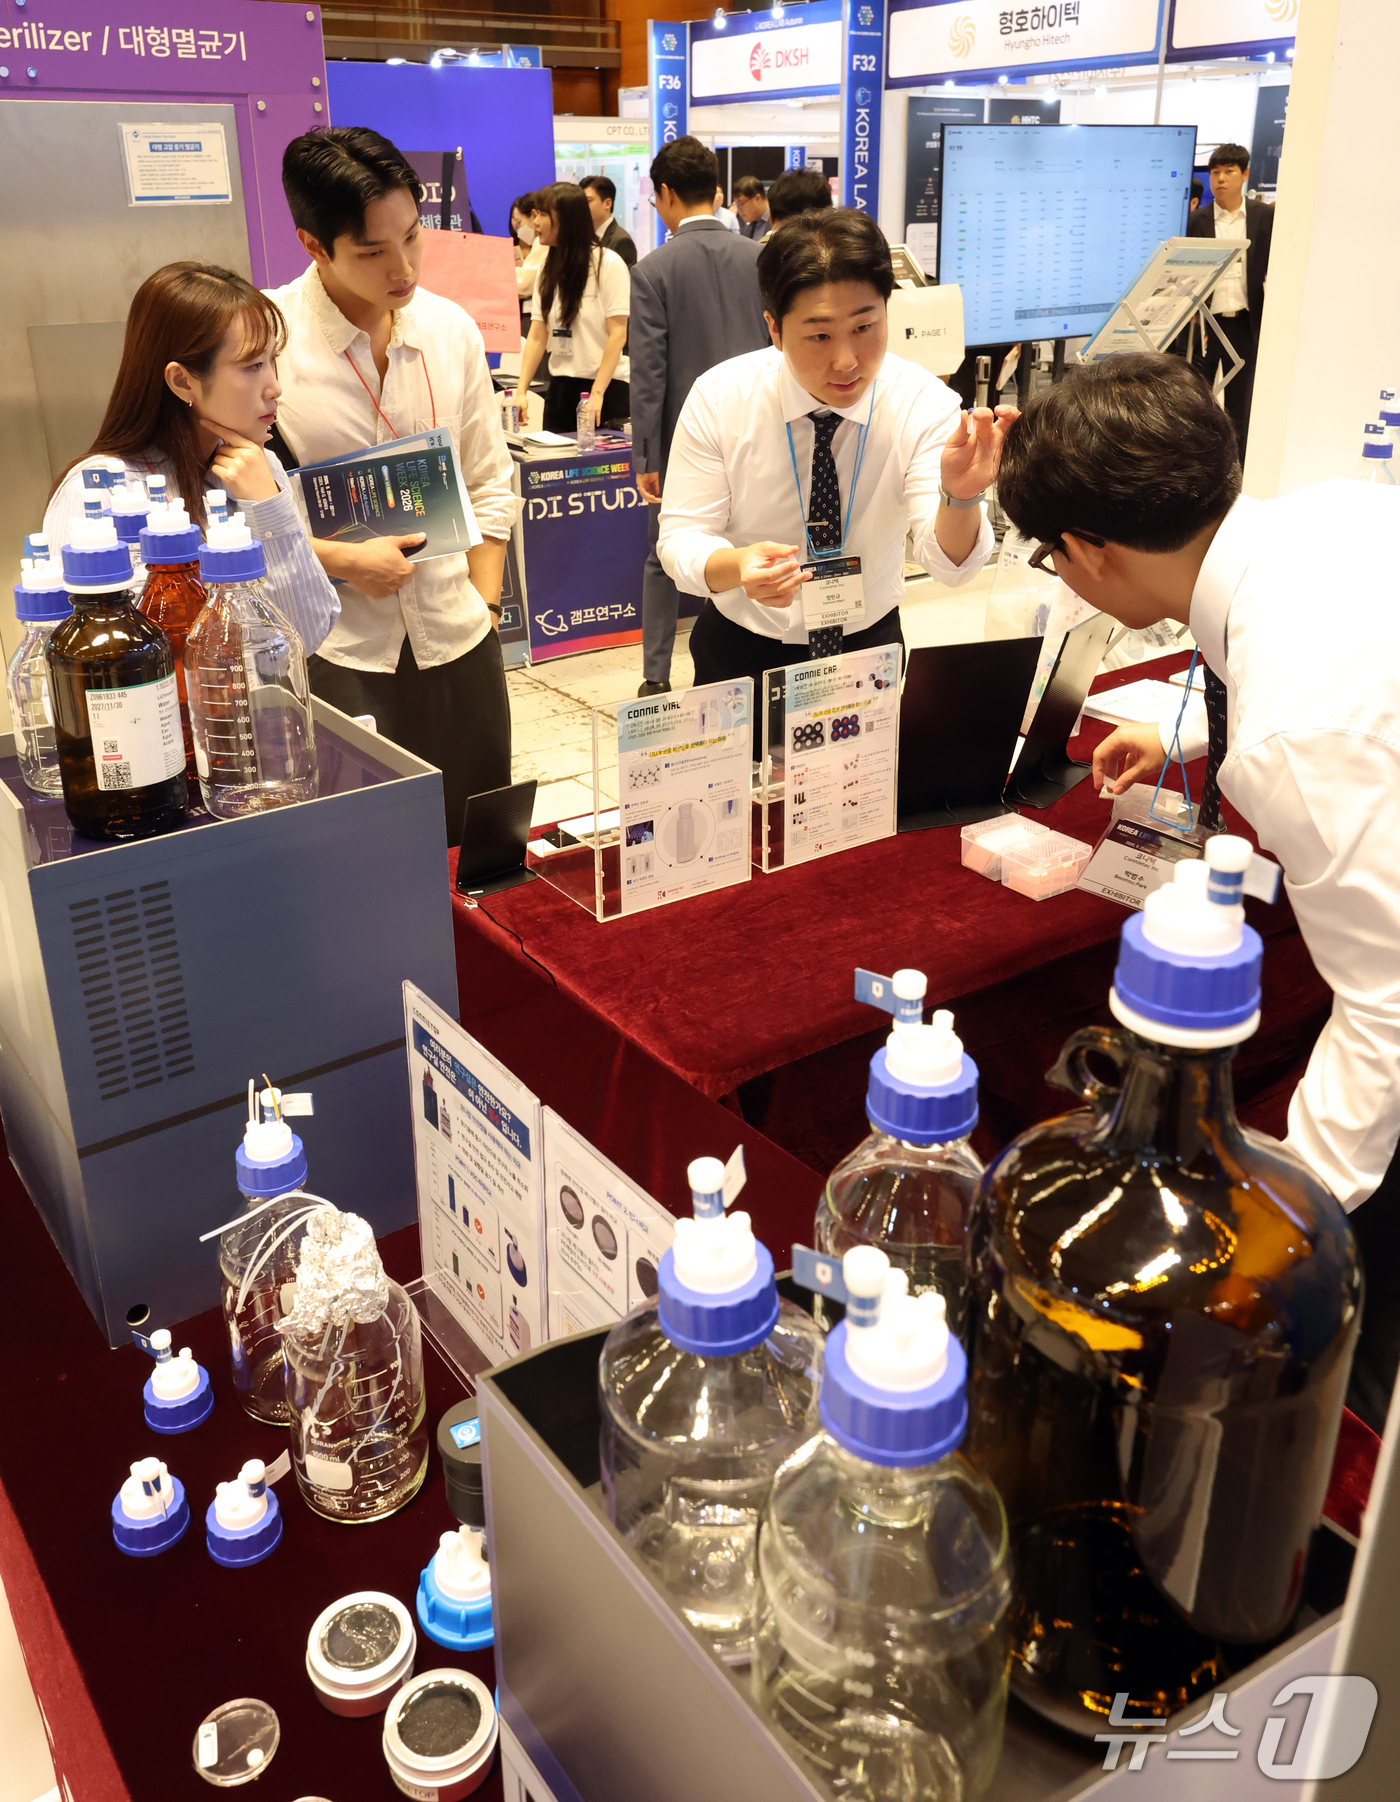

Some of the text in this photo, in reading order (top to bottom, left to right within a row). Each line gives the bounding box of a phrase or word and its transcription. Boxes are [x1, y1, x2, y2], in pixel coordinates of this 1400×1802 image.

[999, 1, 1080, 36] 형호하이텍
[0, 21, 92, 51] erilizer
[118, 25, 247, 61] 대형멸균기
[1004, 32, 1071, 51] Hyungho Hitech
[775, 47, 809, 68] DKSH
[852, 54, 876, 71] F32
[659, 75, 681, 90] F36
[1020, 116, 1041, 124] HHTC
[607, 126, 621, 136] CPT
[639, 126, 649, 136] LT
[853, 108, 870, 215] KOREA LA
[921, 329, 941, 338] PAGE
[417, 459, 431, 488] KOREA
[540, 462, 630, 482] KOREA LIFE SCIENCE WEEK
[396, 463, 413, 511] WEEK 2026
[406, 461, 426, 517] LIFE SCIENCE
[528, 495, 563, 520] DI
[570, 603, 636, 626] 갬프연구소
[822, 611, 848, 619] EXHIBITOR
[821, 617, 847, 626] EXHIBITOR
[795, 668, 821, 682] CONNIE
[158, 699, 170, 708] Water
[628, 705, 659, 719] CONNIE
[237, 716, 250, 724] 600
[1117, 824, 1139, 836] KOREA
[1124, 856, 1150, 869] Connietec
[1135, 853, 1157, 865] 코니텍
[1125, 870, 1144, 882] 박범수
[1101, 888, 1141, 906] EXHIBITOR
[429, 1038, 452, 1067] 여러분의
[453, 1061, 477, 1089] 연구실은
[477, 1084, 511, 1123] 안전한가요?
[422, 1044, 439, 1067] 연구실
[439, 1060, 456, 1084] 안전은
[475, 1095, 488, 1115] 아닌
[501, 1120, 522, 1148] 입니다.
[607, 1191, 622, 1209] POINT
[389, 1360, 400, 1370] 90
[392, 1376, 403, 1387] 80
[393, 1390, 405, 1402] 700
[394, 1406, 406, 1418] 600
[395, 1422, 408, 1434] 500
[397, 1437, 409, 1449] 400
[330, 1454, 340, 1462] ml
[399, 1467, 411, 1480] 200
